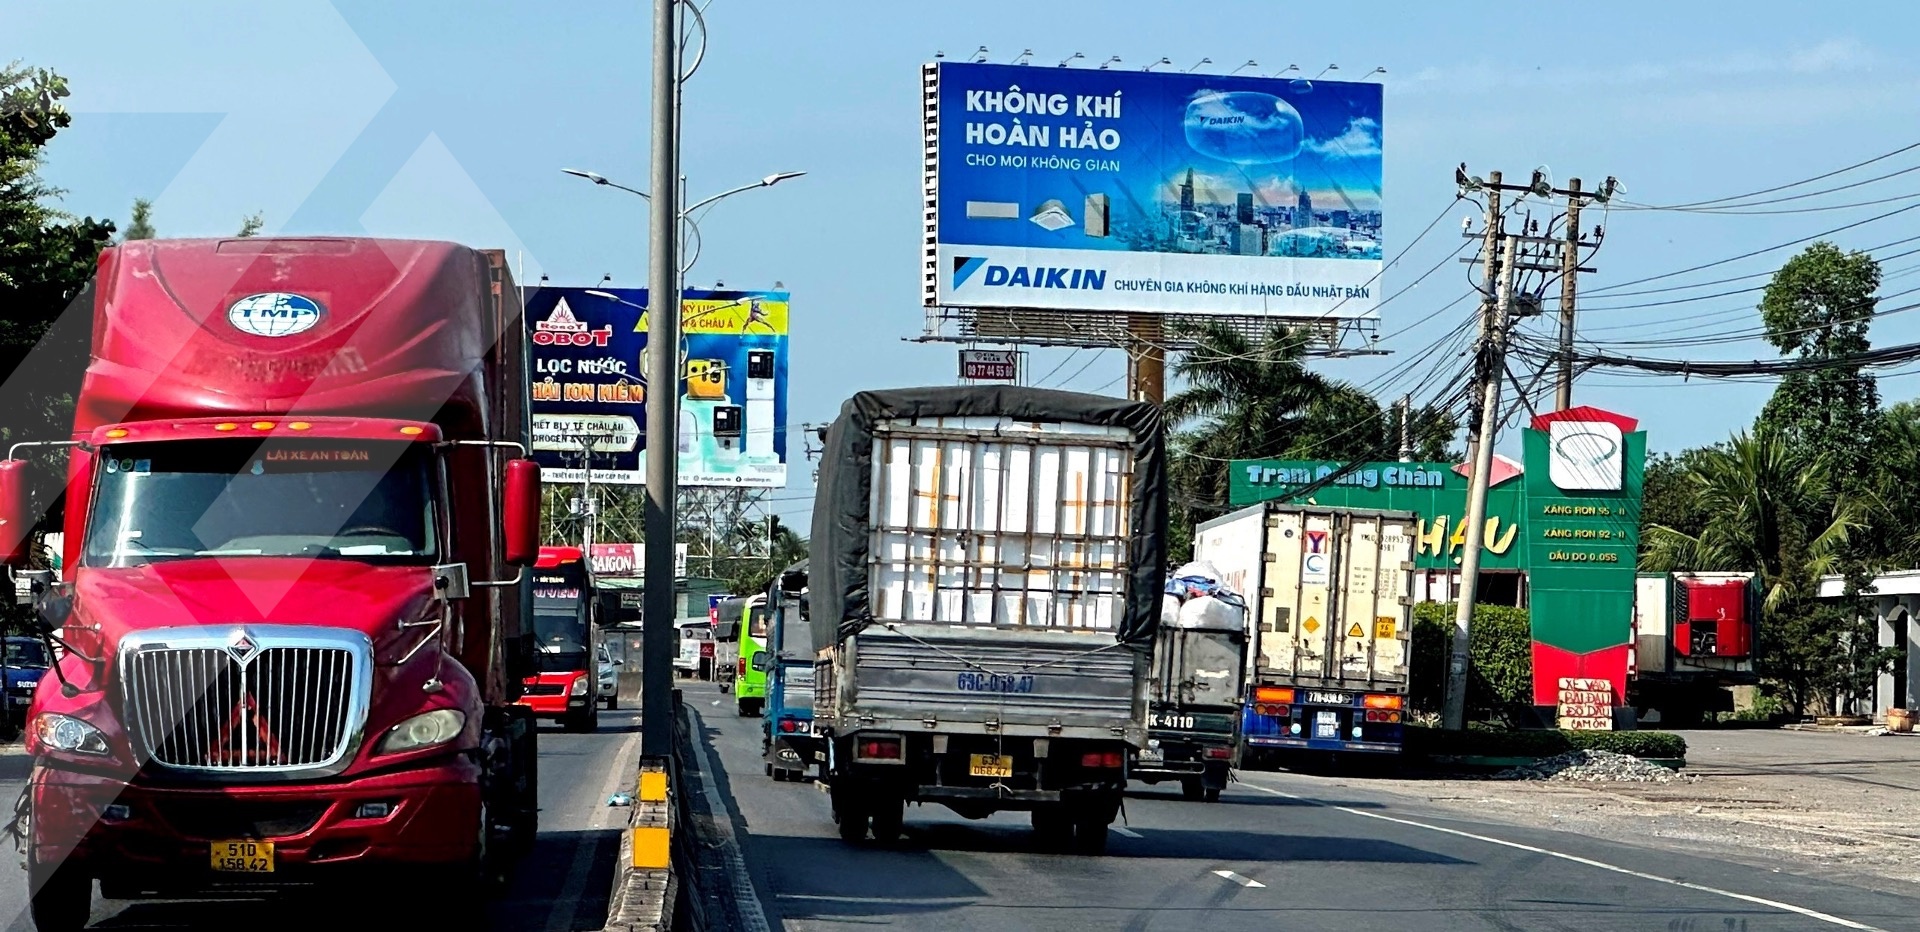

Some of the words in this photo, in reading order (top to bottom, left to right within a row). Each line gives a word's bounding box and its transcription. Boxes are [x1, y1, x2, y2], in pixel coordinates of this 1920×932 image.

[966, 84, 1068, 116] KHÔNG
[1076, 90, 1122, 118] KHÍ
[1209, 116, 1244, 125] DAIKIN
[966, 117, 1049, 147] HOÀN
[1059, 121, 1120, 150] HẢO
[966, 154, 996, 166] CHO
[1000, 155, 1027, 169] MỌI
[1031, 155, 1081, 170] KHÔNG
[1085, 159, 1120, 172] GIAN
[984, 265, 1107, 290] DAIKIN
[1114, 278, 1162, 292] CHUYÊN
[1164, 281, 1184, 293] GIA
[1187, 280, 1227, 295] KHÔNG
[1229, 282, 1249, 295] KHÍ
[1251, 282, 1283, 297] HÀNG
[1312, 286, 1343, 300] NHẬT
[242, 309, 311, 318] TMP
[699, 318, 725, 328] CHÂU
[533, 328, 612, 346] OBOT
[536, 359, 572, 376] LỌC
[577, 357, 627, 374] NƯỚC
[978, 365, 985, 376] 77
[987, 365, 995, 376] 44
[564, 383, 595, 402] ION
[533, 419, 550, 430] HIẾT
[533, 434, 568, 443] DROGEN
[291, 451, 308, 460] XE
[310, 451, 329, 460] AN
[1246, 465, 1310, 489] Trạm
[1383, 464, 1443, 486] Chân
[1575, 506, 1596, 514] RON
[1575, 530, 1596, 538] RON
[1598, 530, 1610, 539] 92
[1572, 552, 1587, 560] DO
[592, 556, 632, 571] SAIGON
[1149, 714, 1194, 728] K-4110
[228, 843, 257, 857] 51D
[219, 858, 268, 871] 158.42
